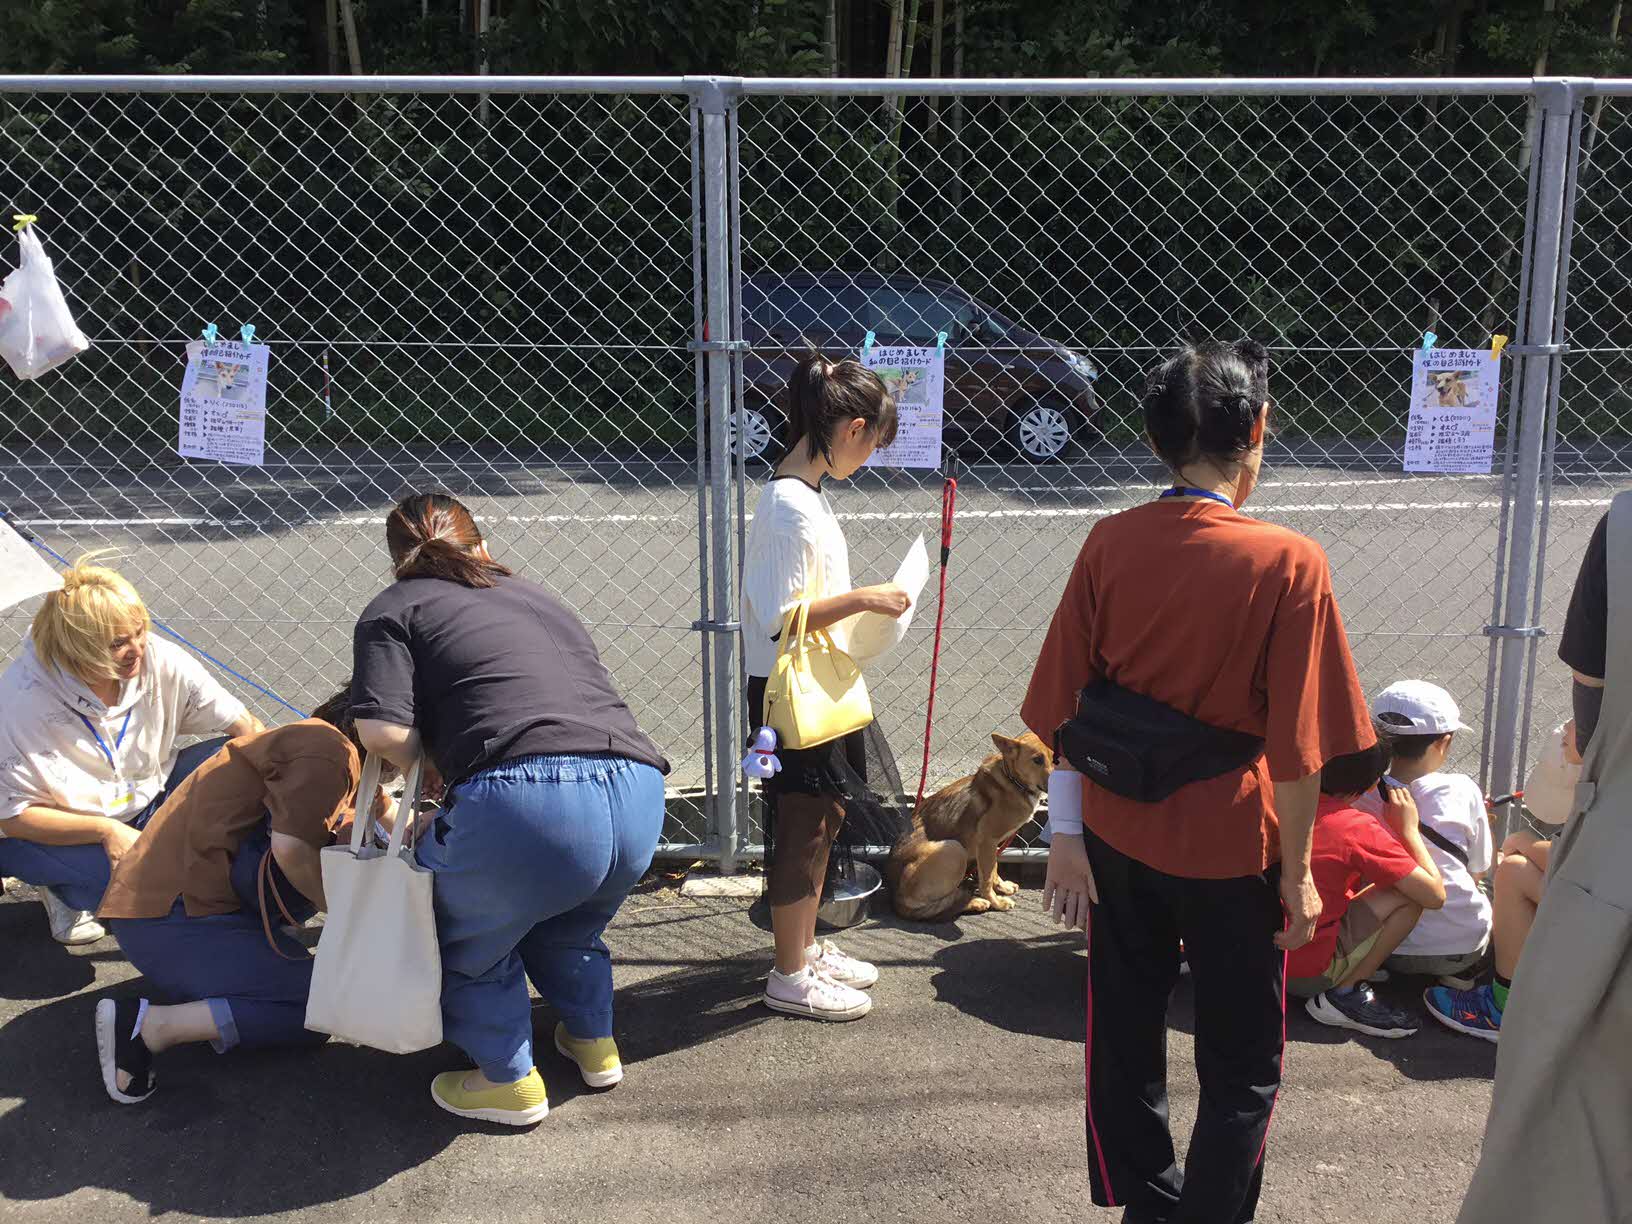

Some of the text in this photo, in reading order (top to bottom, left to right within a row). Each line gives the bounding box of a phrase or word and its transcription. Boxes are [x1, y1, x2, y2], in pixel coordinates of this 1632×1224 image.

[879, 349, 927, 357] はじめまして
[1430, 351, 1476, 359] はじめまして
